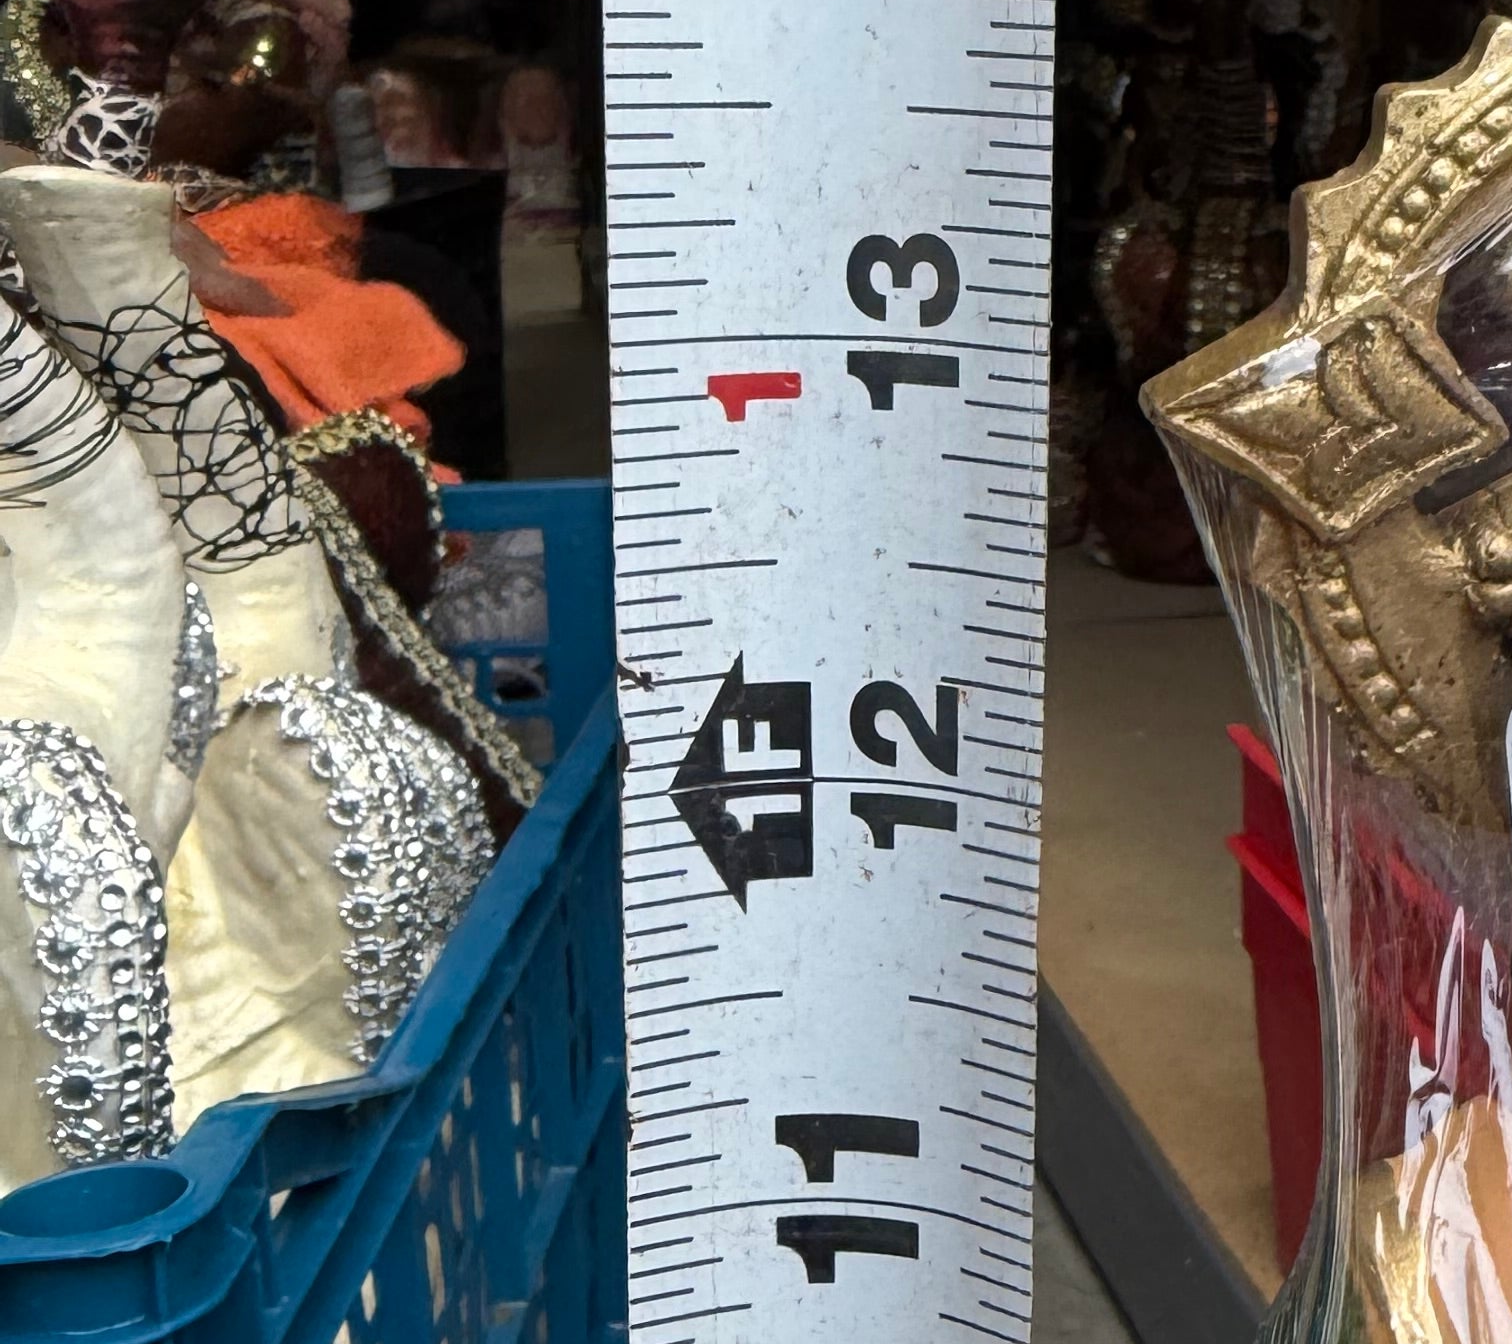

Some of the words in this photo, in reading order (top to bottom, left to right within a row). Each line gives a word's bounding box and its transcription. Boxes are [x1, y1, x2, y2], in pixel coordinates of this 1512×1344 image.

[707, 372, 801, 422] 1
[846, 232, 960, 411] 13
[849, 680, 959, 850] 12
[775, 1113, 920, 1284] 11
